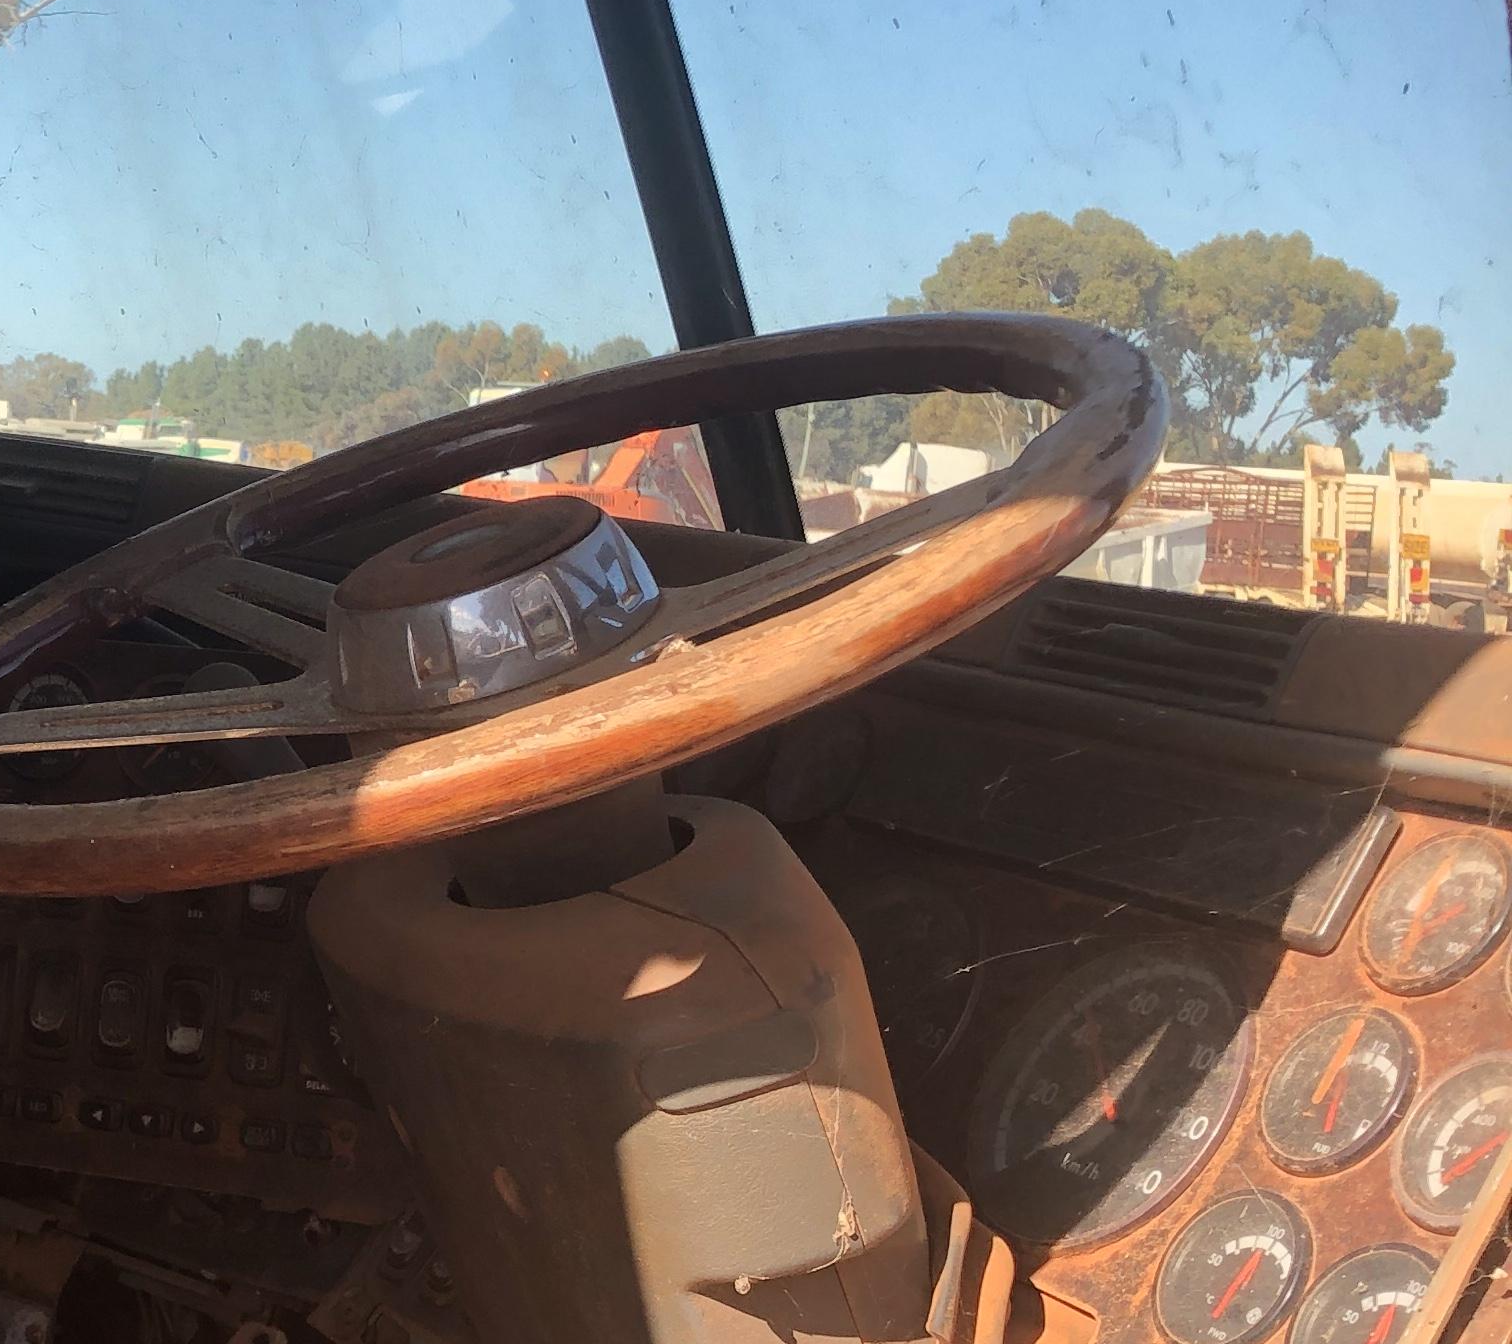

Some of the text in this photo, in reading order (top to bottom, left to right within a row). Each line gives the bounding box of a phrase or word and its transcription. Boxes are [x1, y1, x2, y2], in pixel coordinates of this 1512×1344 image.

[1176, 998, 1209, 1027] 80
[1029, 1080, 1061, 1106] 20
[1059, 1151, 1101, 1182] km/h
[1266, 1224, 1286, 1240] 100
[1207, 1252, 1224, 1267] 50
[1407, 1279, 1427, 1297] 100
[1341, 1309, 1360, 1324] 50
[1207, 1326, 1228, 1341] FWD
